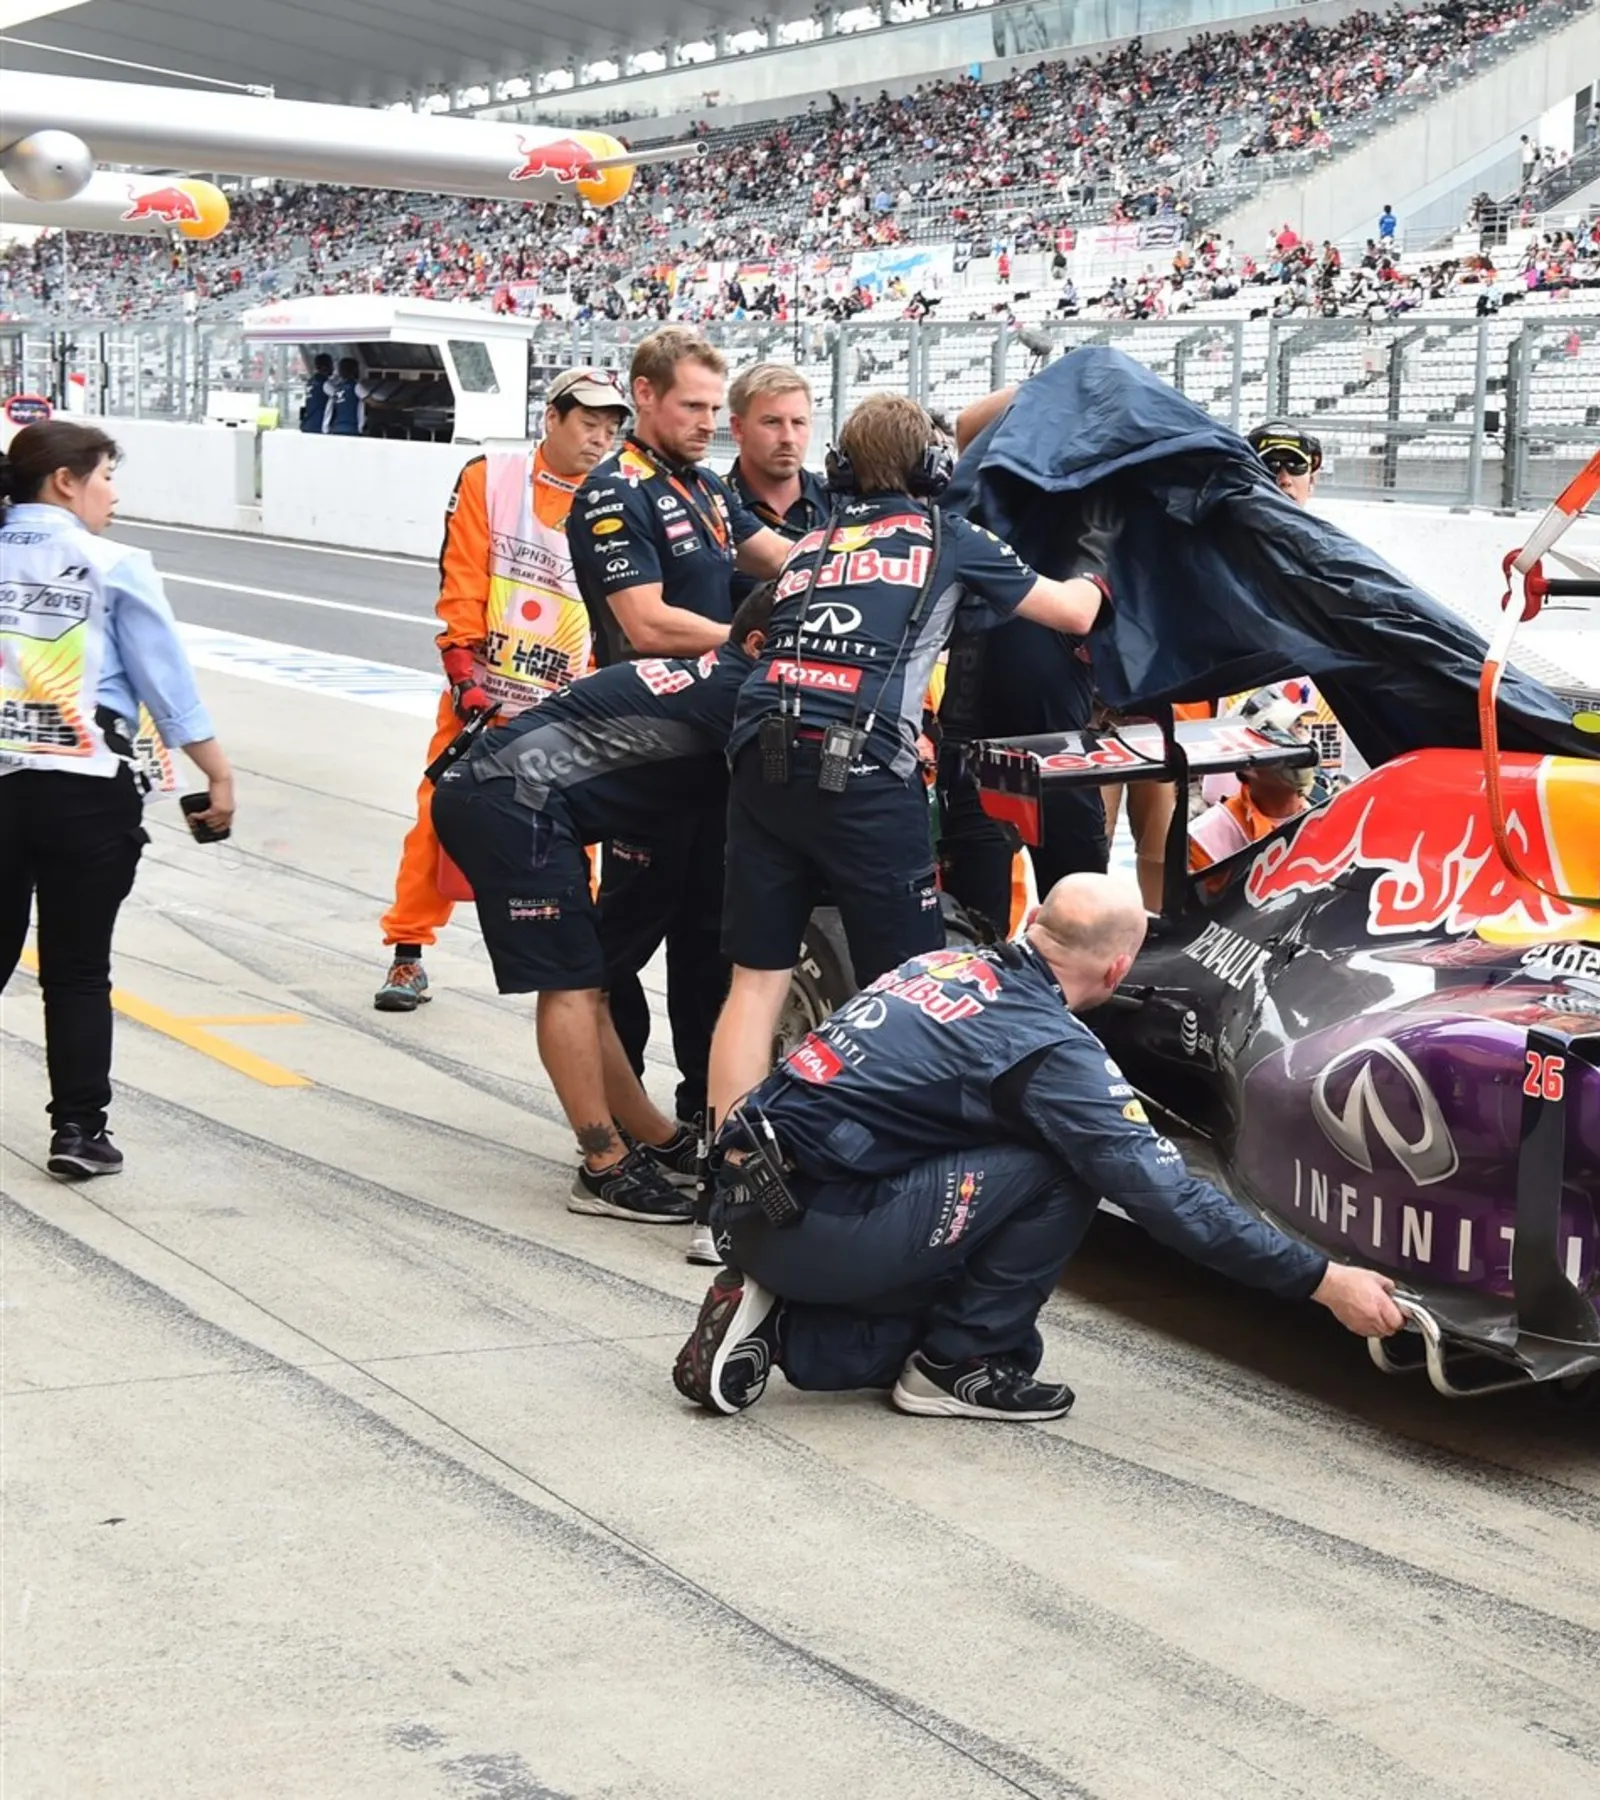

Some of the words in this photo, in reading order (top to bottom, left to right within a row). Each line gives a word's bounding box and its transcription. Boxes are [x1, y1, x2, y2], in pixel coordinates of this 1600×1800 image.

[846, 545, 934, 588] Bul
[775, 662, 853, 689] TOTAL
[1180, 919, 1272, 992] RENAULT
[903, 973, 985, 1025] Bull
[1523, 1050, 1565, 1102] 26
